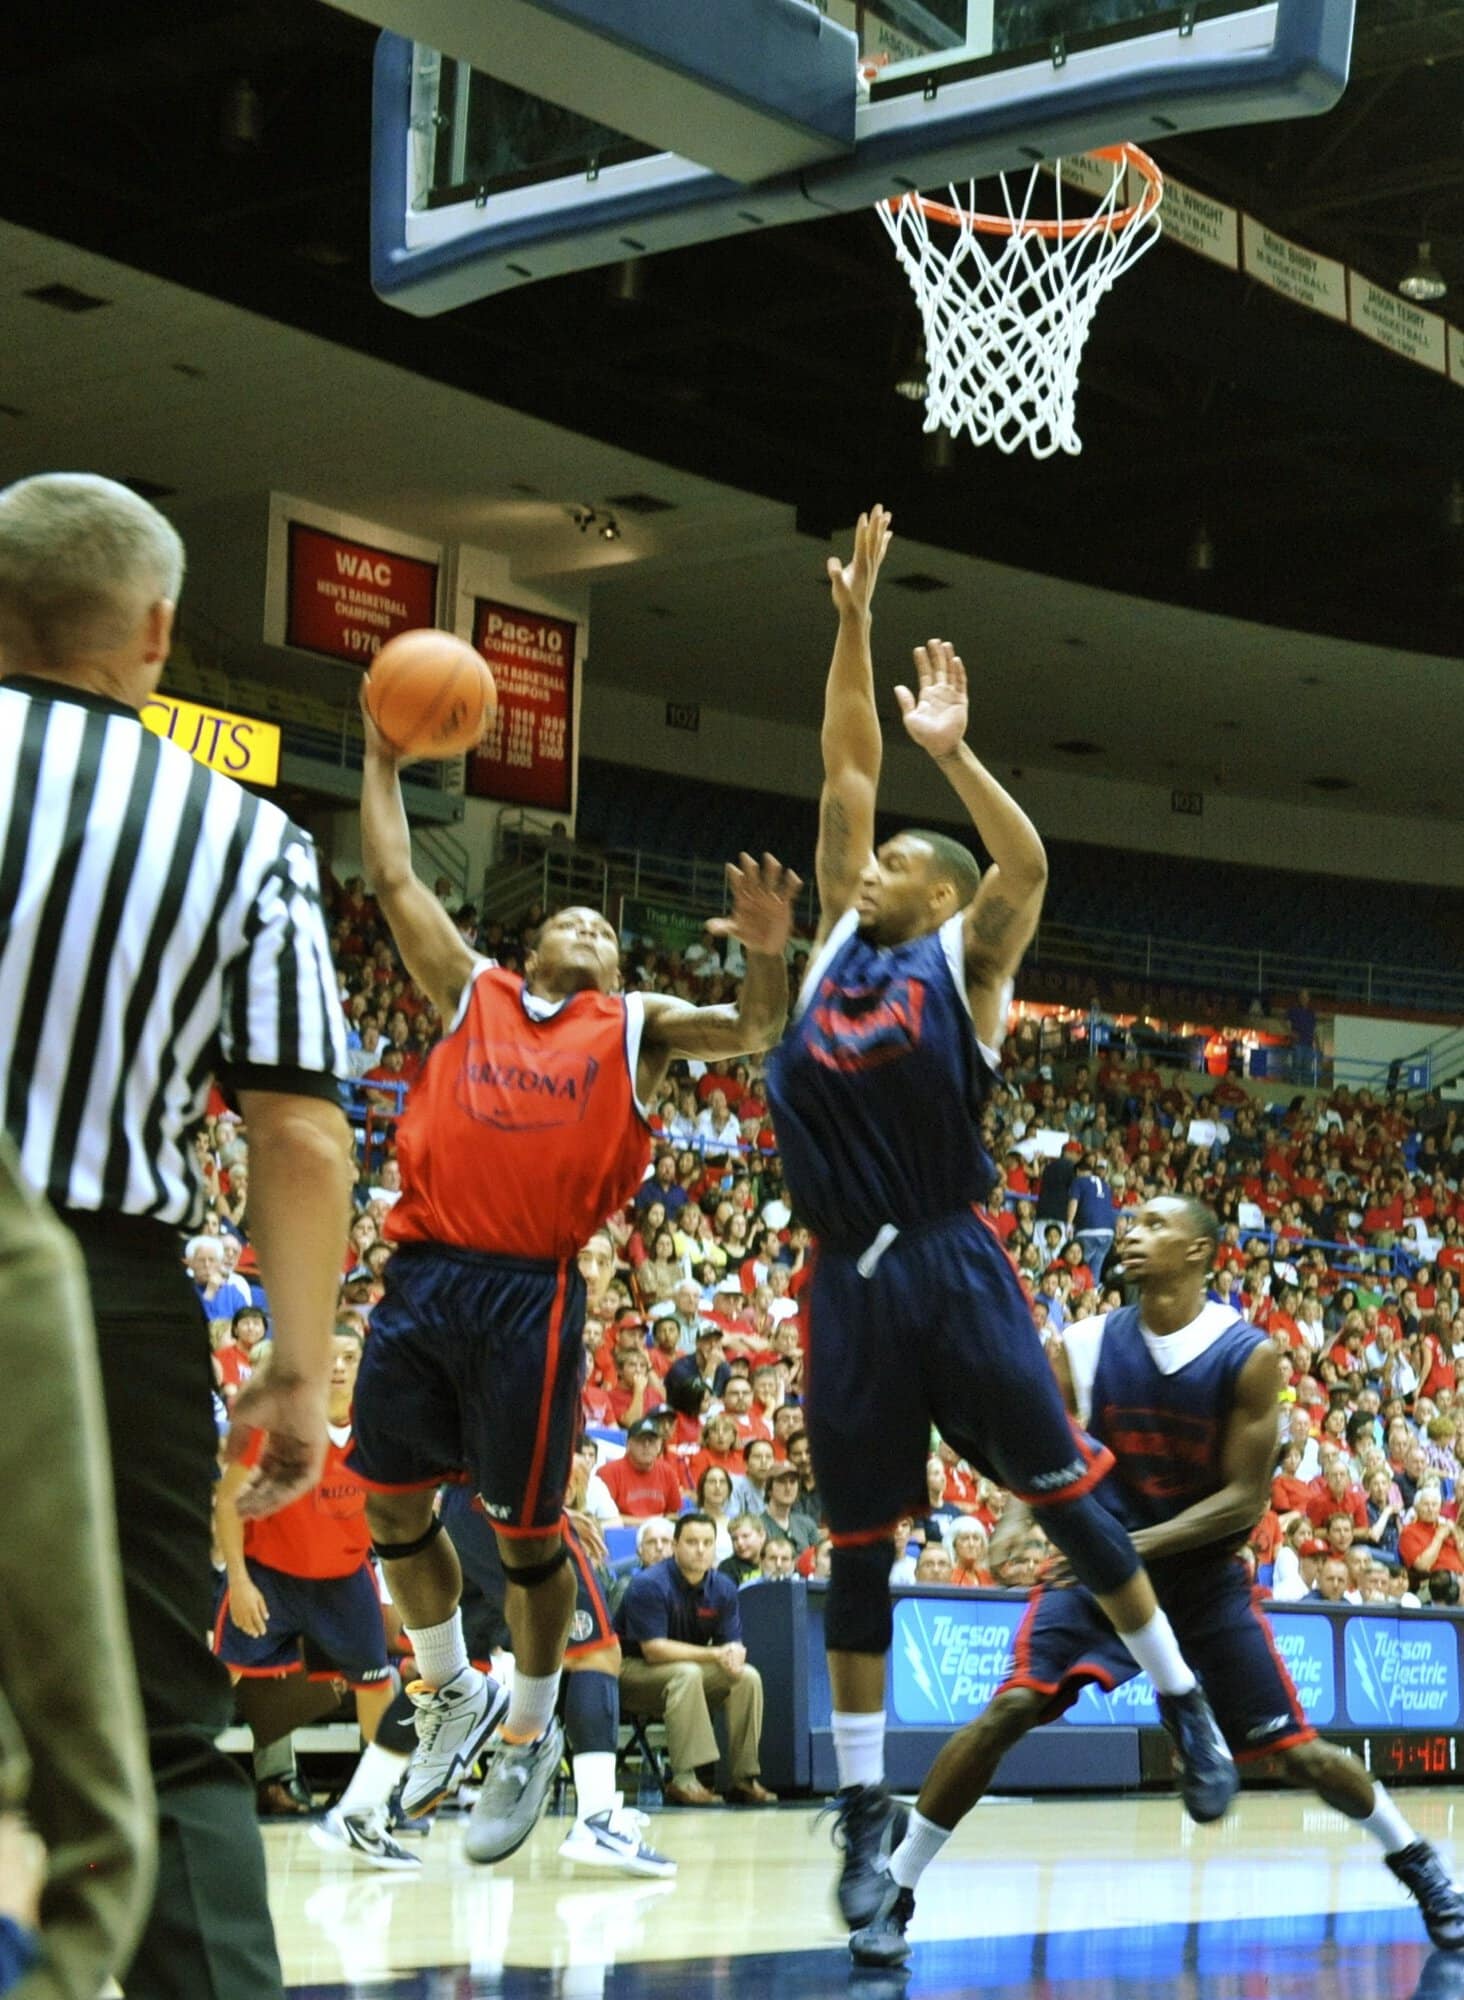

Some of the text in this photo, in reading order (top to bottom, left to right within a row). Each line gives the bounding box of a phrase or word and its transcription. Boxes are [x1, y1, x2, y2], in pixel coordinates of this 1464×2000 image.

[335, 550, 391, 587] WAC
[335, 601, 390, 629] CHAMPIONS
[349, 588, 408, 618] BASKETBALL
[487, 612, 562, 652] Pac-10
[484, 637, 564, 667] CONFERENCE
[932, 1615, 1010, 1649] Tucson
[1374, 1631, 1432, 1660] Tucson
[1381, 1657, 1447, 1686] Electric
[1389, 1686, 1447, 1711] Power
